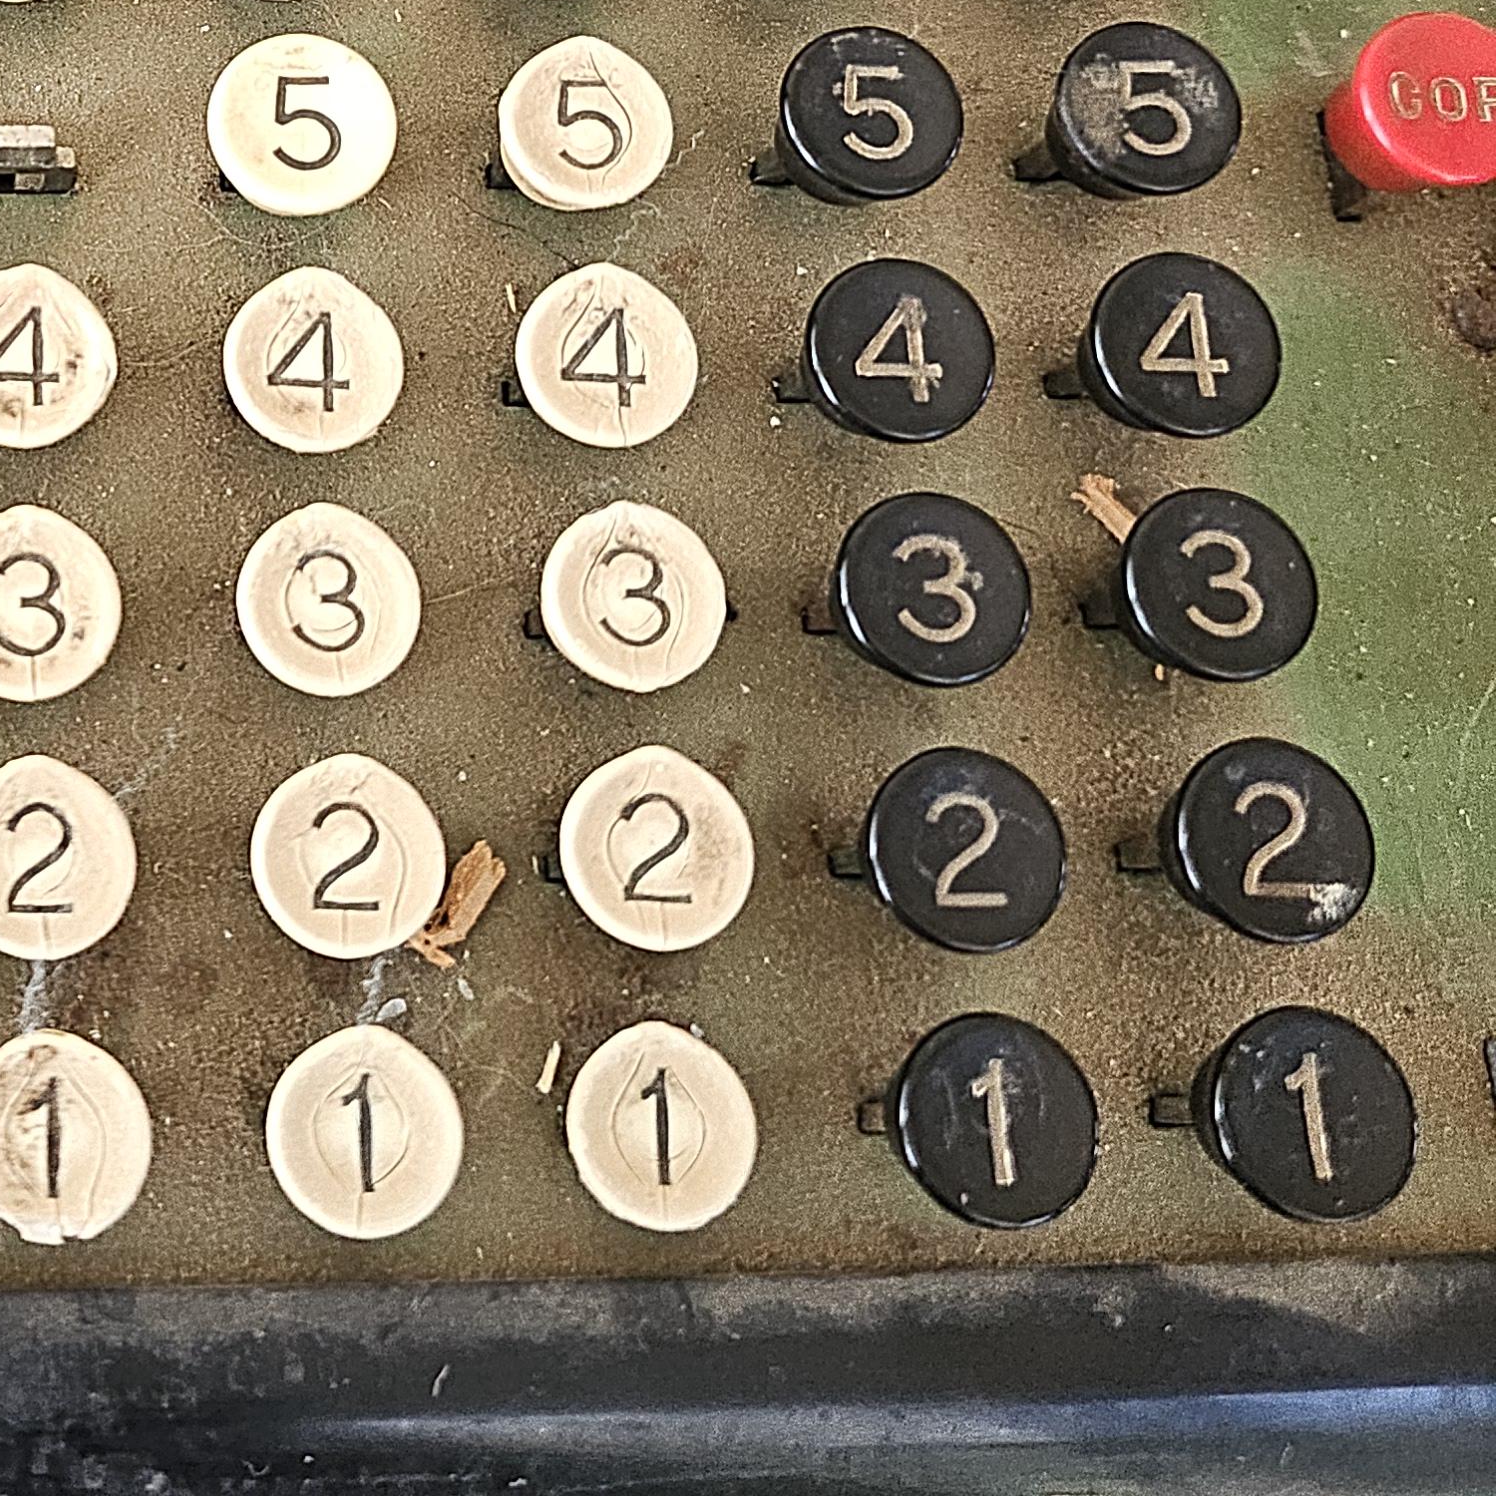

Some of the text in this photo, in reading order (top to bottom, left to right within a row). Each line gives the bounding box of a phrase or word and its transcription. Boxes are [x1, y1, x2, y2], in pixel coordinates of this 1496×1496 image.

[273, 76, 342, 171] 5
[558, 79, 622, 170] 5
[843, 64, 913, 160] 5
[1123, 60, 1192, 156] 5
[268, 311, 349, 411] 4
[561, 308, 646, 408] 4
[855, 295, 943, 402] 4
[1140, 291, 1229, 397] 4
[292, 549, 365, 651] 3
[598, 547, 671, 646] 3
[892, 533, 976, 643] 3
[1179, 529, 1264, 638] 3
[8, 802, 73, 913] 2
[313, 801, 379, 910] 2
[624, 793, 692, 904] 2
[926, 792, 1008, 905] 2
[1235, 782, 1313, 898] 2
[17, 1077, 61, 1198] 1
[342, 1072, 374, 1192] 1
[642, 1067, 670, 1186] 1
[971, 1057, 1015, 1185] 1
[1284, 1051, 1333, 1182] 1
